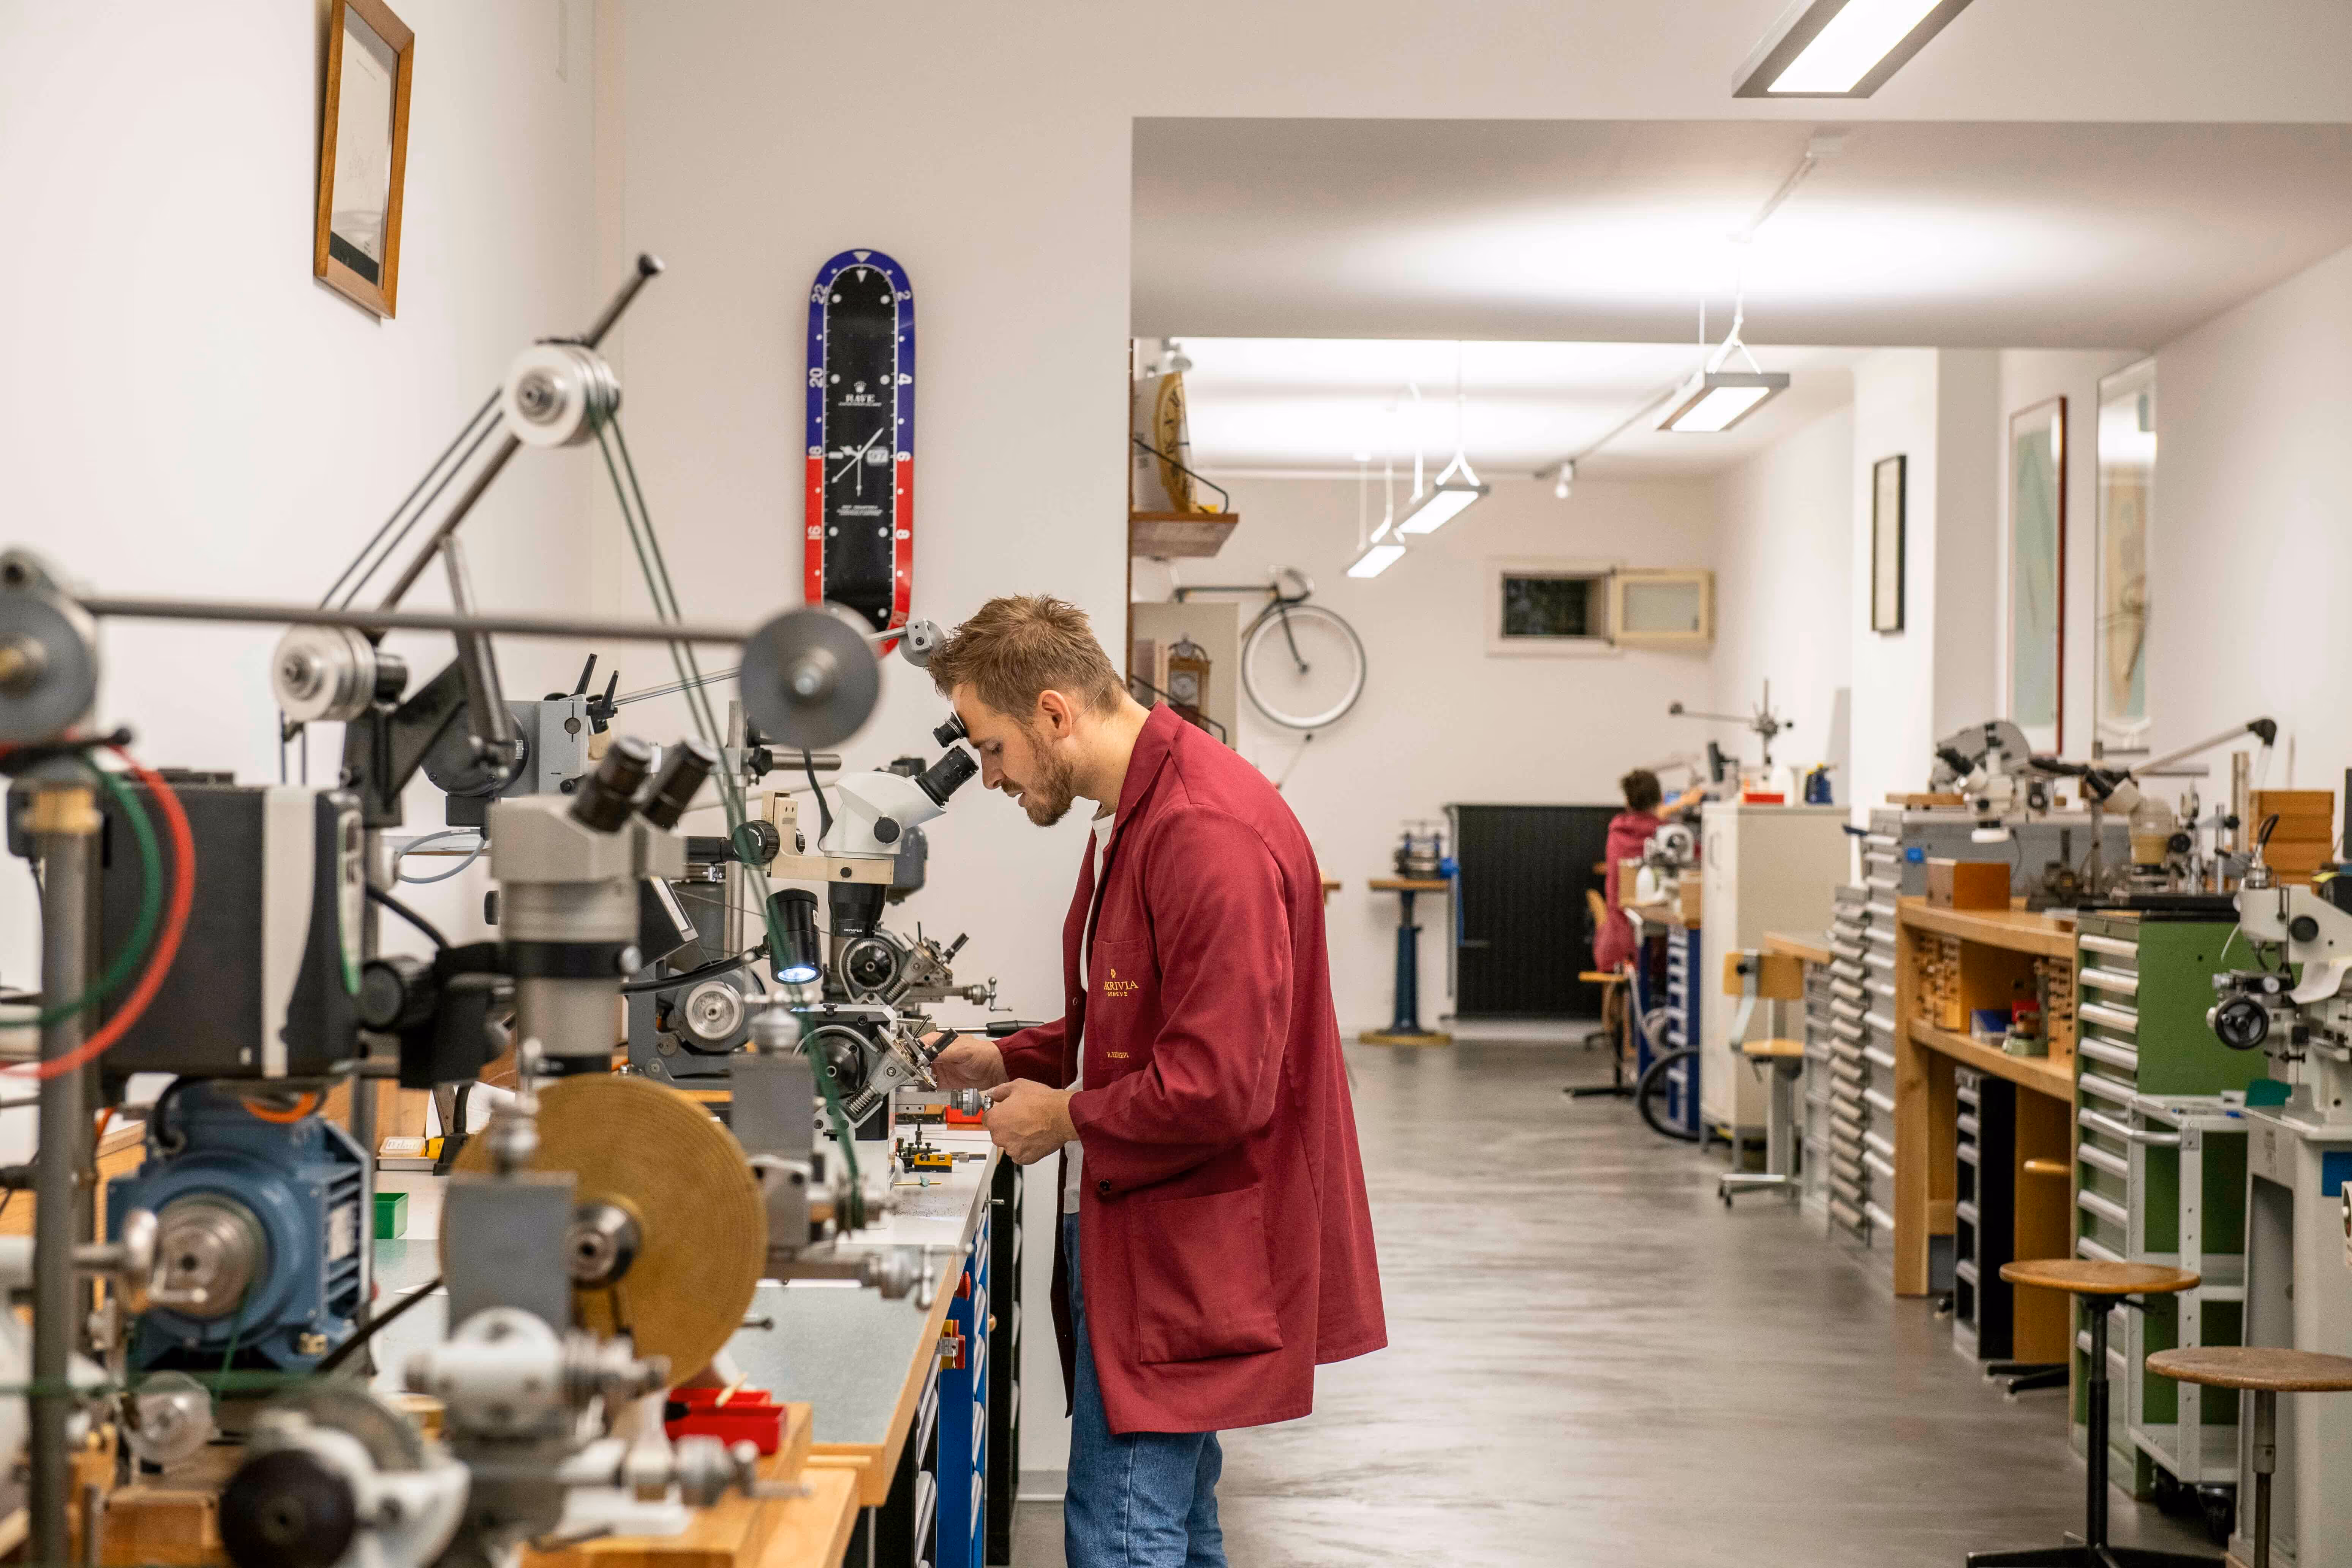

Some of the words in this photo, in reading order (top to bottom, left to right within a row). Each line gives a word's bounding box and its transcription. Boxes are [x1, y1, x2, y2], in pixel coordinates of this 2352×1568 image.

[811, 283, 829, 304] 22
[897, 289, 912, 301] 2
[809, 367, 823, 388] 20
[898, 373, 912, 385] 4
[809, 446, 822, 459] 18
[897, 451, 911, 462] 6
[808, 525, 822, 541] 16
[896, 529, 911, 540] 8
[1103, 980, 1139, 990] AKRIVIA
